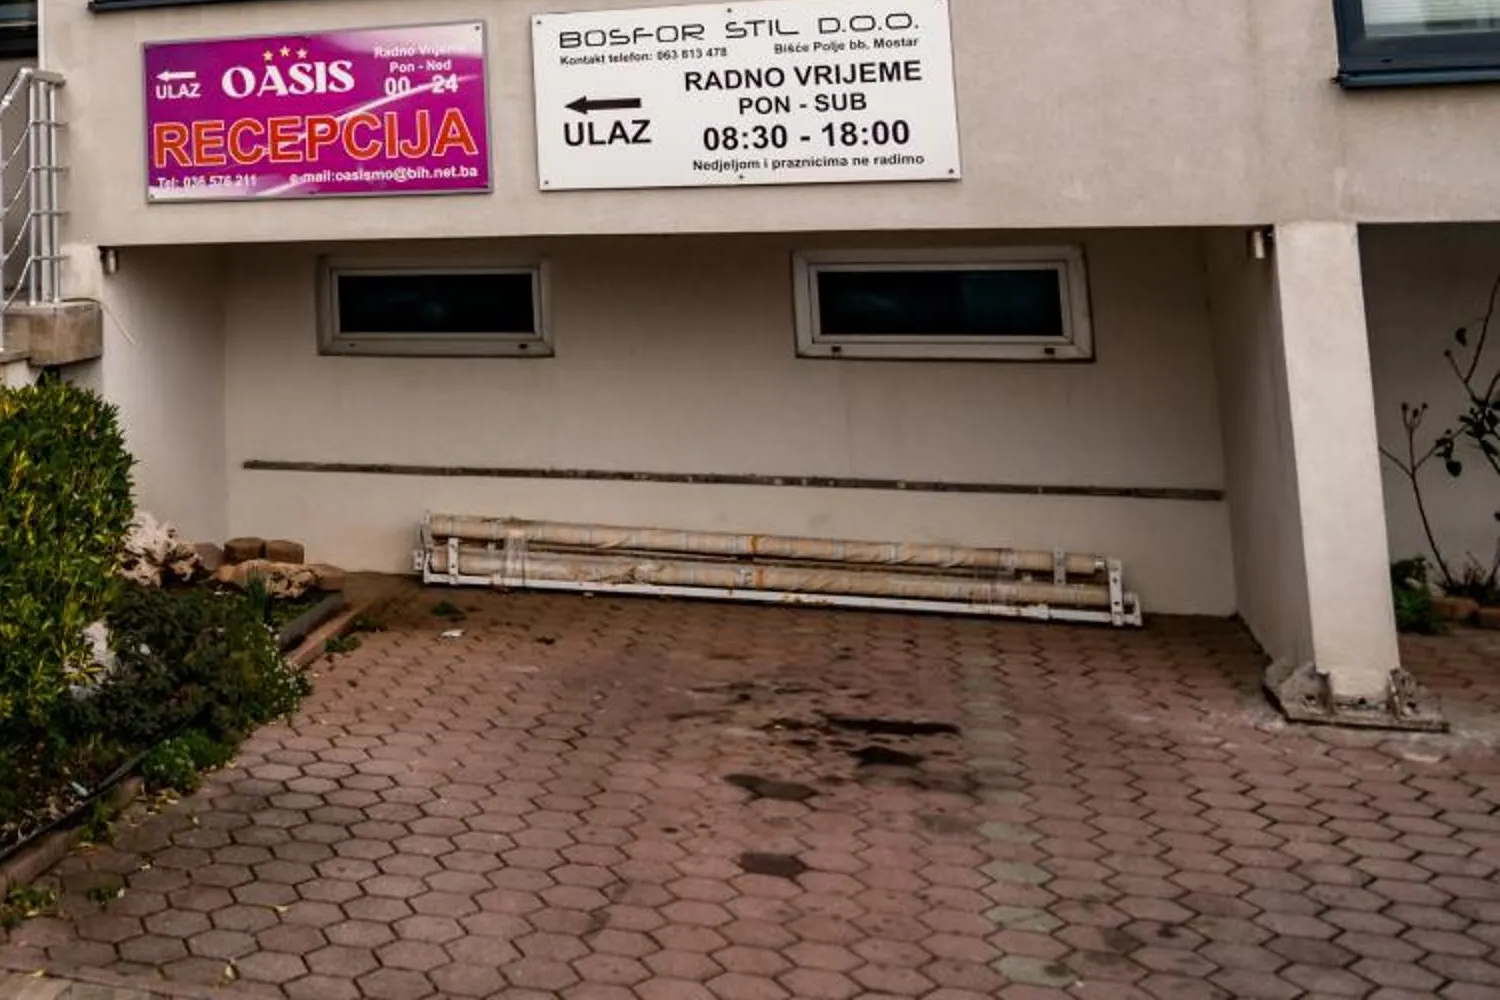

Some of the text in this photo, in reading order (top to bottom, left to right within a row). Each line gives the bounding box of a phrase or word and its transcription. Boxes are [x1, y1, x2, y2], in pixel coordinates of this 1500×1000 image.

[559, 12, 919, 49] BOSFOR STIL D.O.O.
[373, 45, 415, 58] Radno
[813, 40, 846, 54] Polje
[873, 36, 919, 49] Mostar
[389, 61, 415, 73] Pon
[426, 60, 452, 71] Ned
[560, 55, 606, 65] Kontakt
[608, 51, 653, 63] telefon:
[221, 60, 355, 98] OASIS
[385, 76, 410, 96] 00
[431, 74, 459, 94] 24
[685, 60, 923, 91] RADNO VRIJEME
[155, 83, 201, 99] ULAZ
[739, 97, 791, 115] PON
[815, 93, 867, 112] SUB
[153, 107, 478, 168] RECEPCIJA
[563, 120, 652, 147] ULAZ
[703, 125, 788, 152] 08:30
[822, 120, 911, 147] 18:00
[692, 158, 760, 172] Nedjeljom
[772, 155, 848, 172] praznicima
[852, 156, 871, 166] ne
[873, 153, 925, 165] radimo
[236, 174, 257, 185] 211
